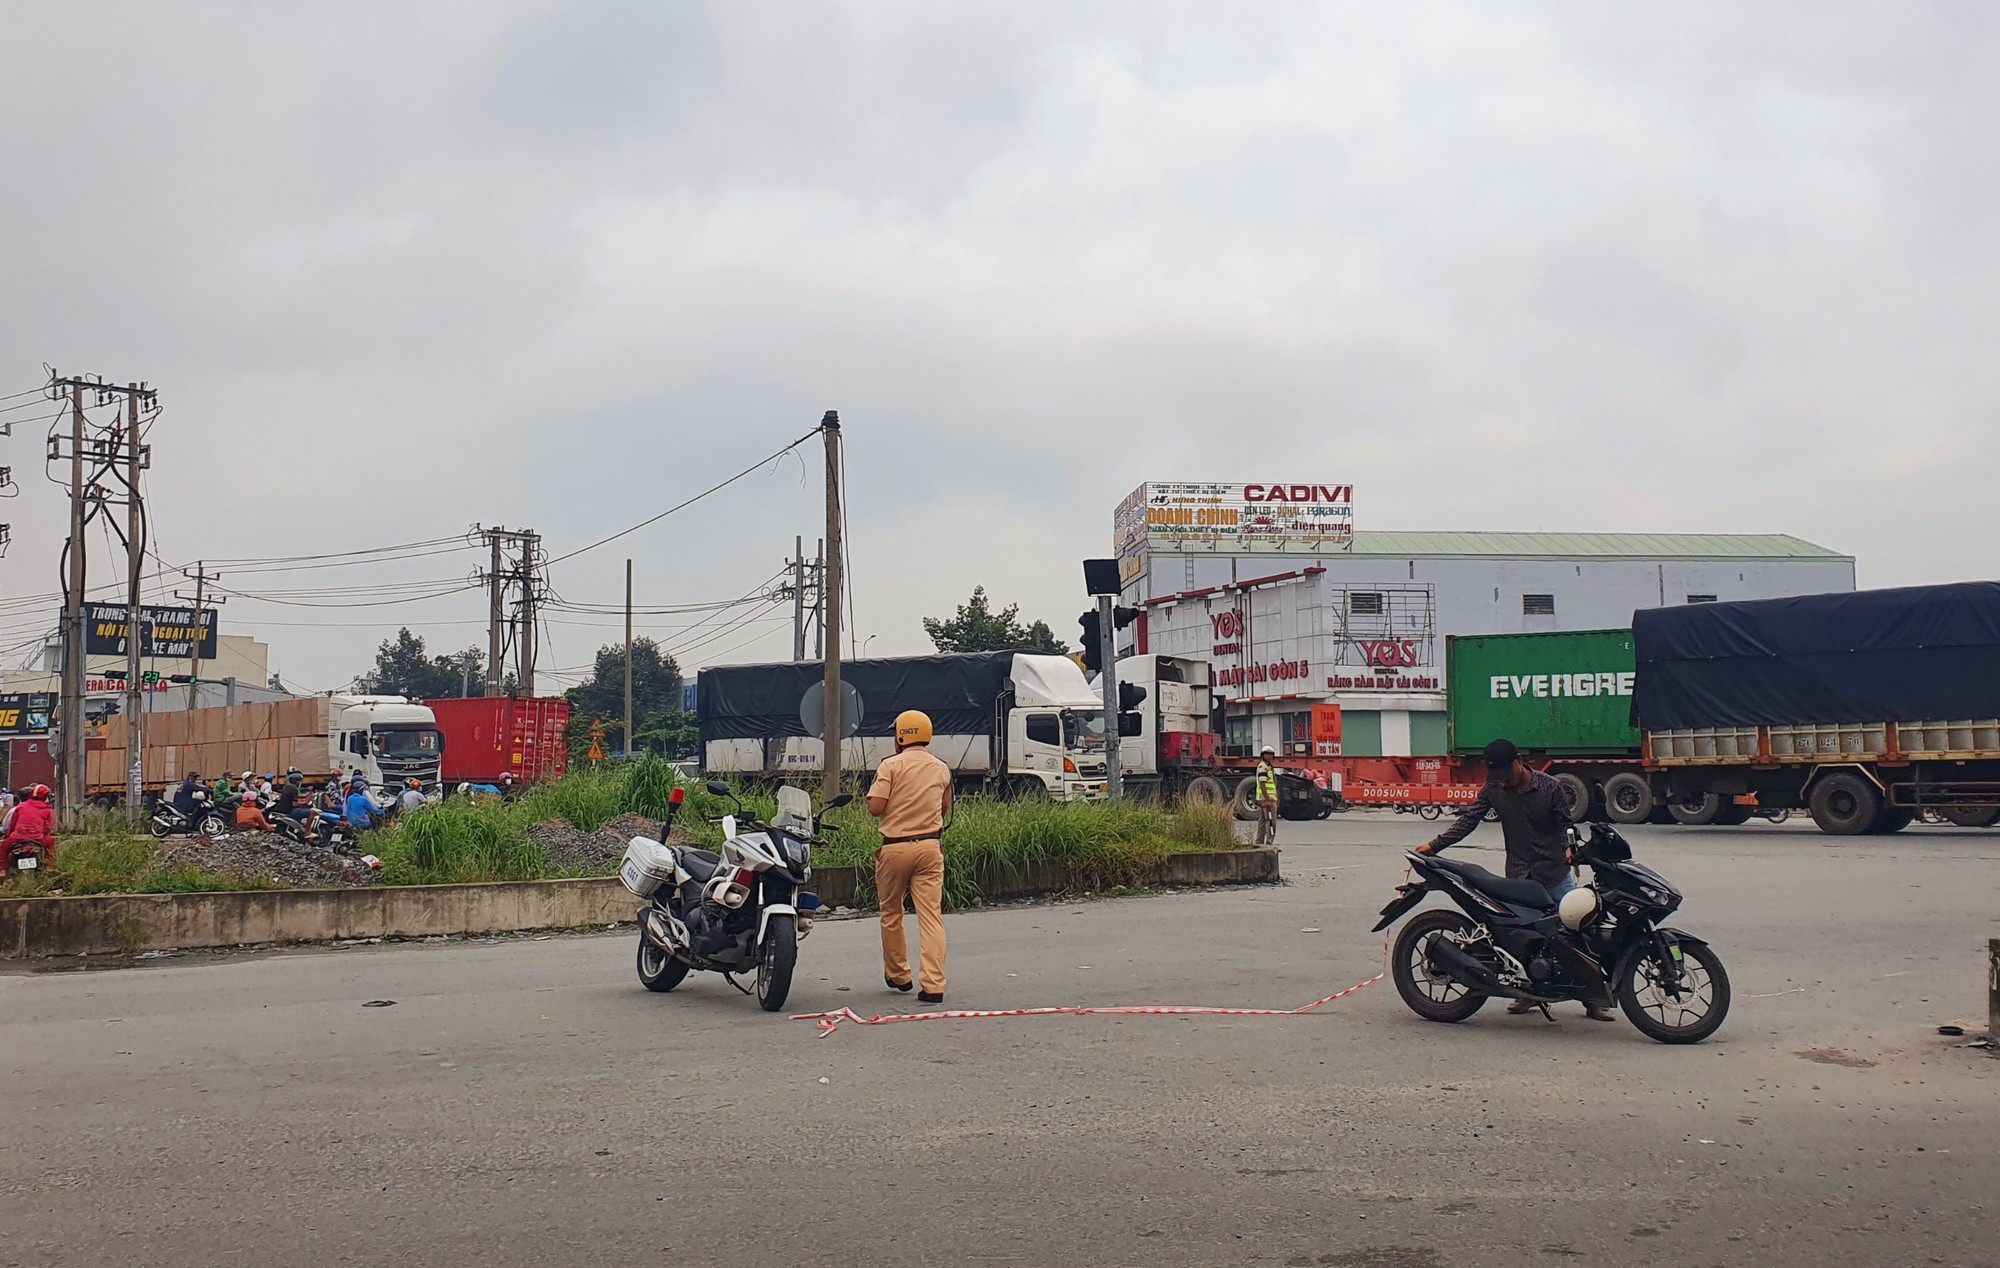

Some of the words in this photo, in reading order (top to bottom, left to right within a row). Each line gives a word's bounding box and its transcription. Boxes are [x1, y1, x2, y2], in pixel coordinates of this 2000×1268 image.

[1243, 485, 1350, 502] CADIVI
[1147, 507, 1192, 525] DOANH
[92, 607, 125, 621] TRUNG
[1300, 660, 1309, 678] 5
[144, 672, 158, 683] 23
[899, 727, 920, 735] CSGT
[1363, 788, 1410, 798] DOOSUNG
